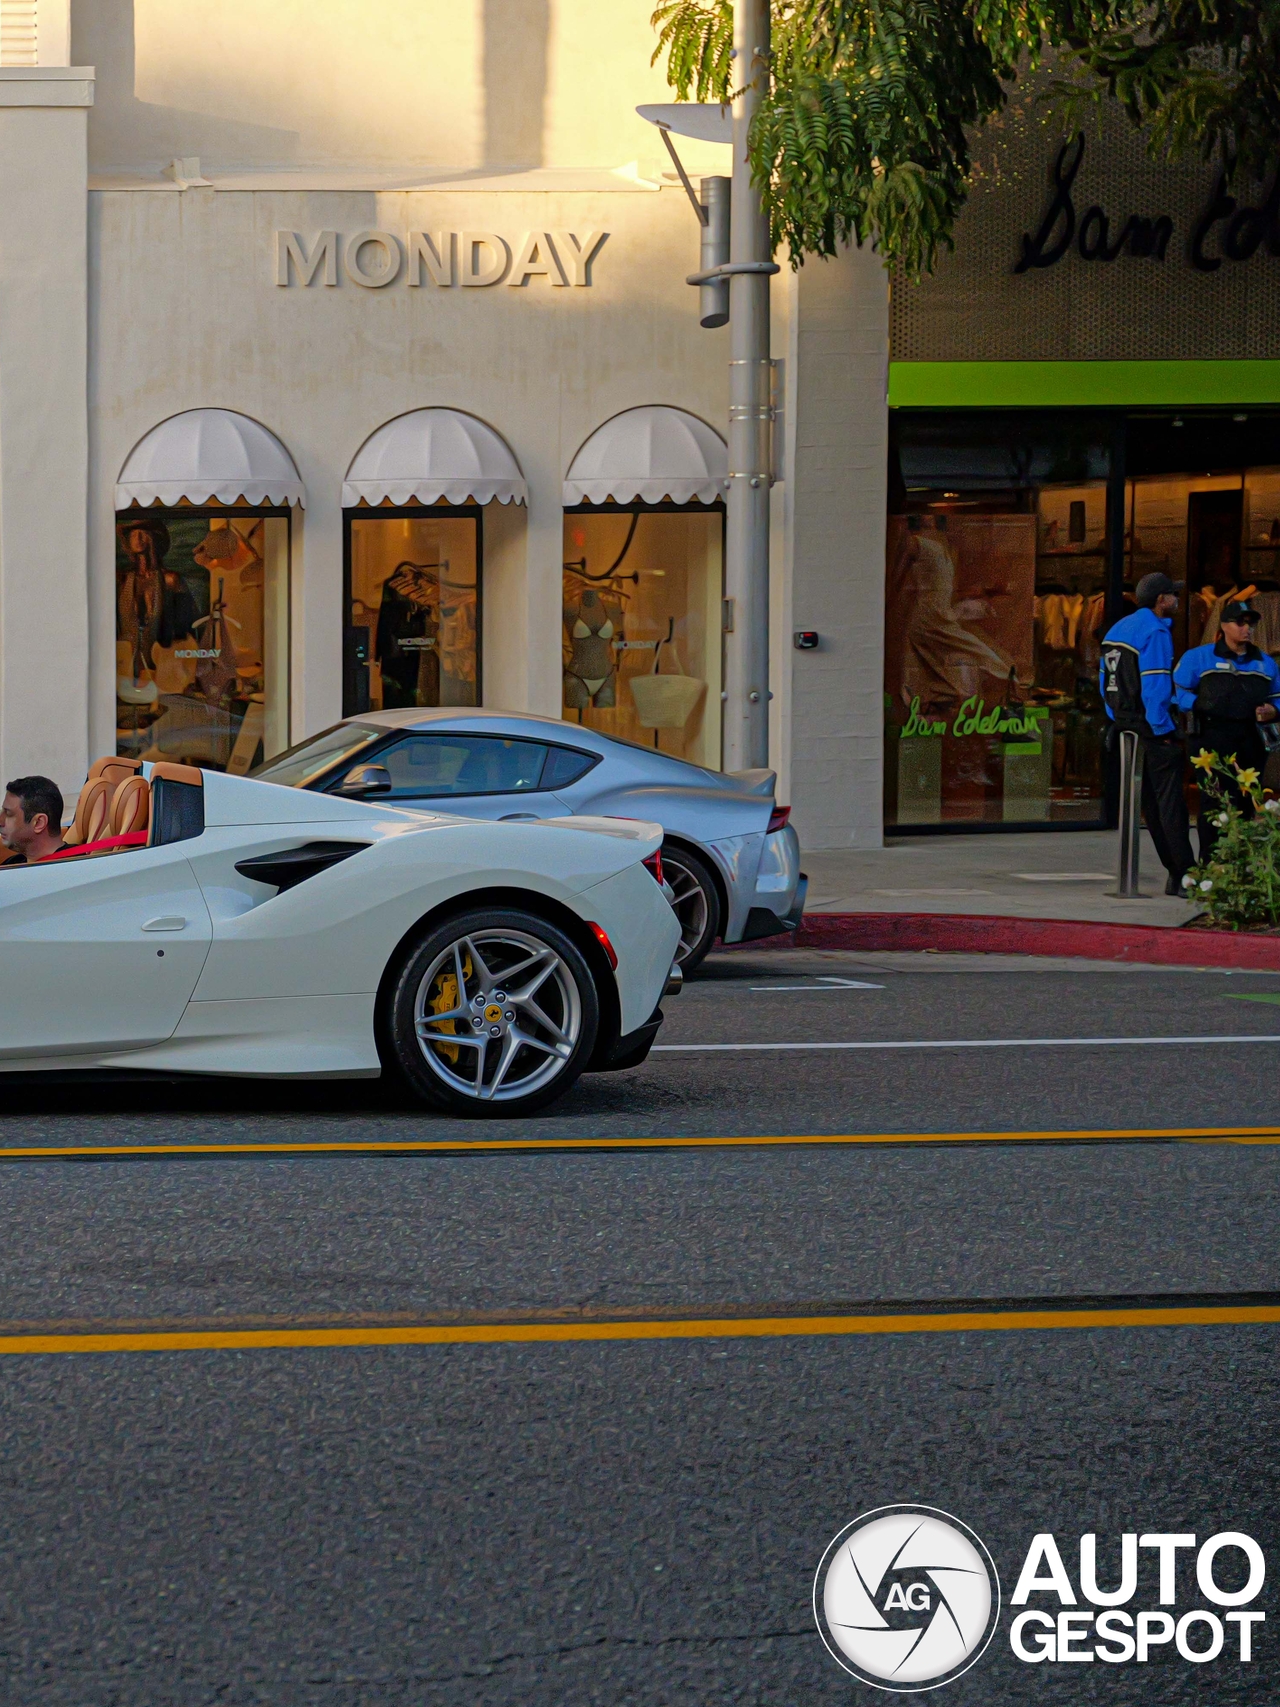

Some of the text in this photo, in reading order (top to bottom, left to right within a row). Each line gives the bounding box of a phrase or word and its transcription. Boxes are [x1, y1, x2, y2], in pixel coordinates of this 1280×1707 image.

[1014, 131, 1177, 274] Sam
[276, 230, 610, 288] MONDAY
[174, 648, 222, 659] MONDAY
[899, 694, 1043, 739] Sam Edelman
